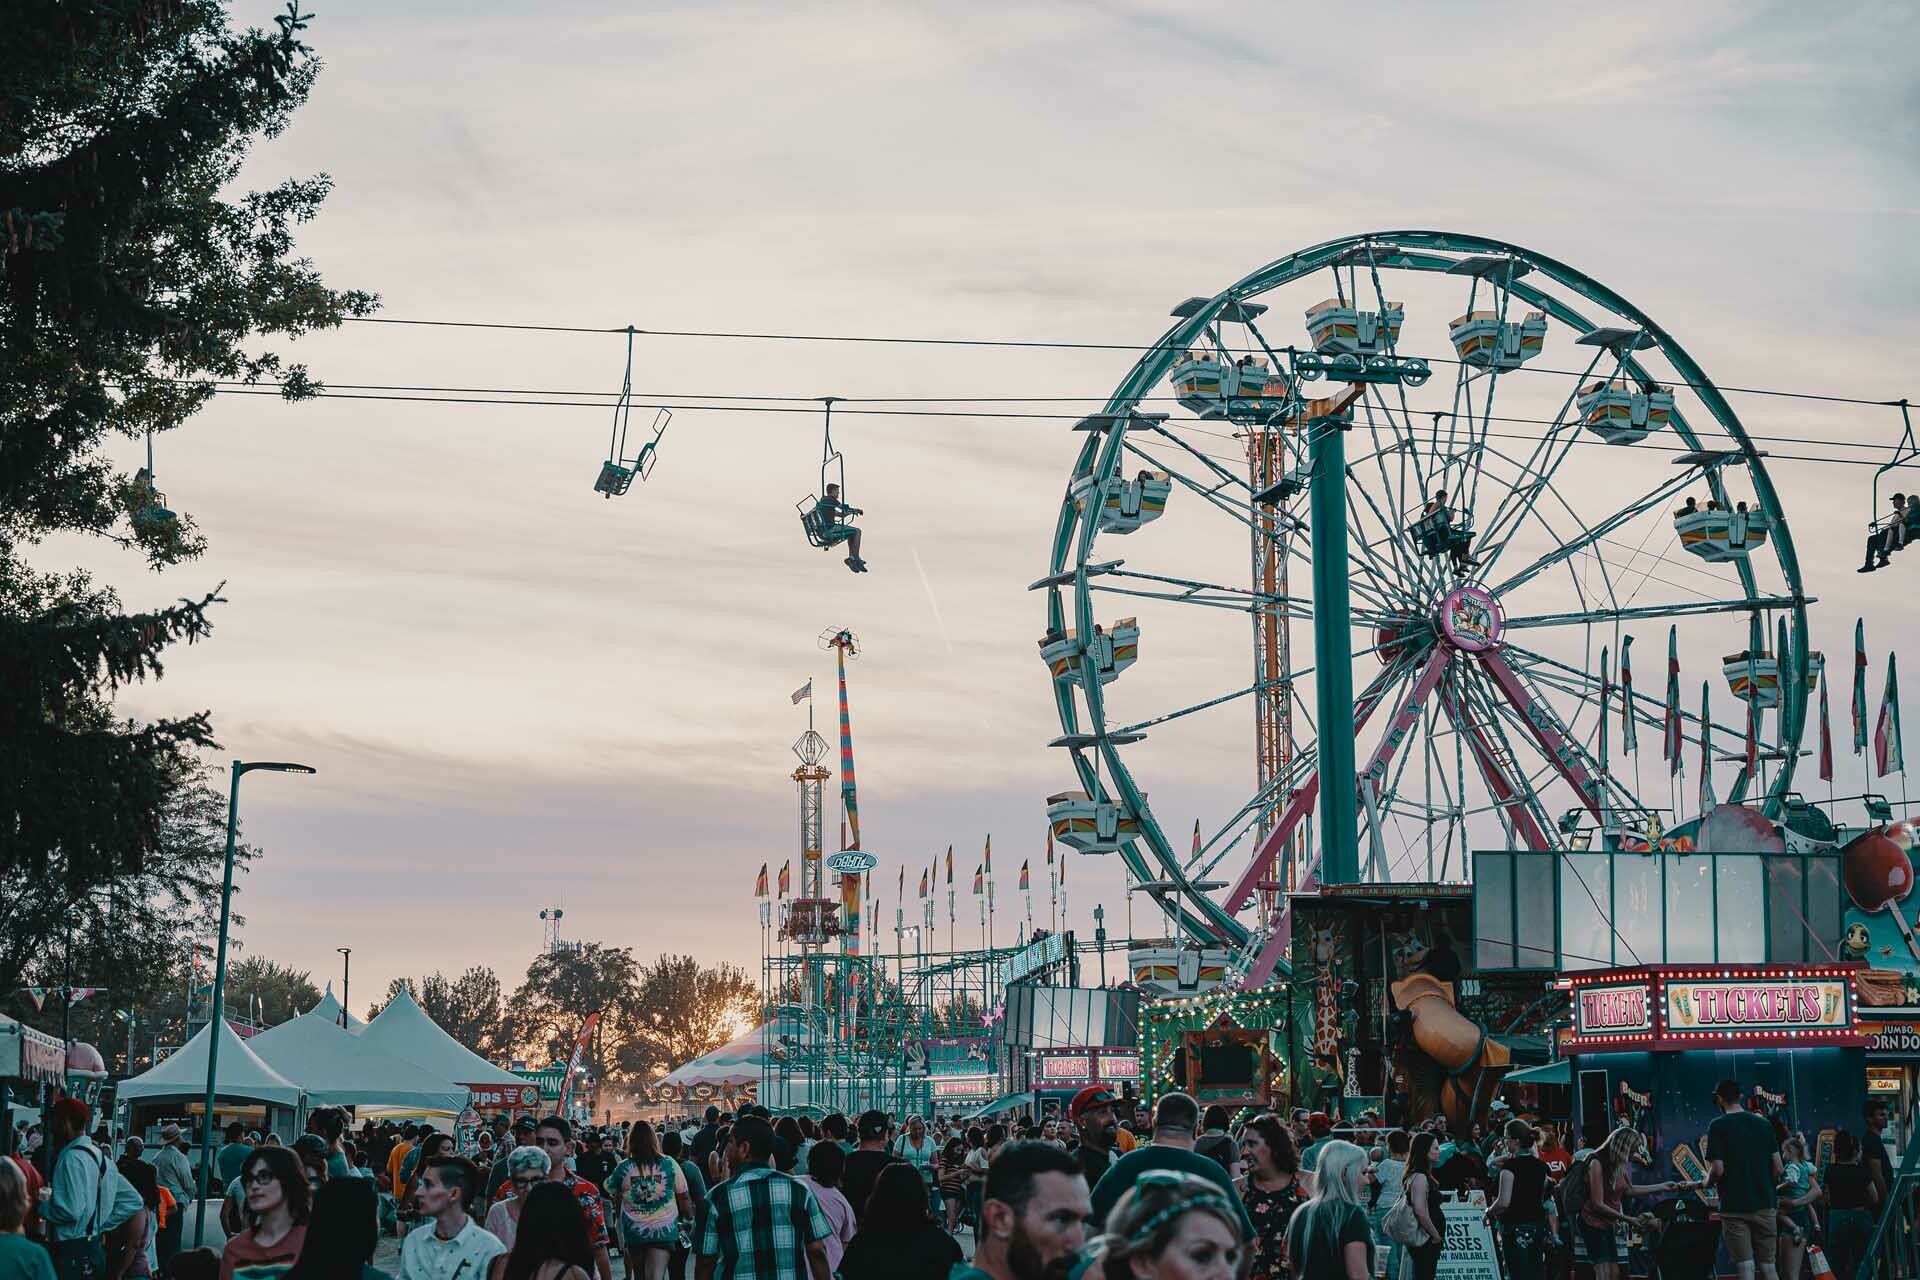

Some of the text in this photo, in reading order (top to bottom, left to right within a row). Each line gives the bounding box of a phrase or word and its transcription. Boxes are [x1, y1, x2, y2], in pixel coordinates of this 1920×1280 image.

[1383, 887, 1424, 896] ADVENTURE
[1582, 989, 1645, 1029] TICKETS
[1693, 986, 1820, 1024] TICKETS
[1883, 1025, 1914, 1035] JUMBO
[1865, 1034, 1899, 1050] ORN
[1045, 1059, 1087, 1076] TICKETS
[1446, 1223, 1470, 1237] AST
[1441, 1237, 1482, 1251] ASSES
[1450, 1252, 1489, 1260] AVAILABLE
